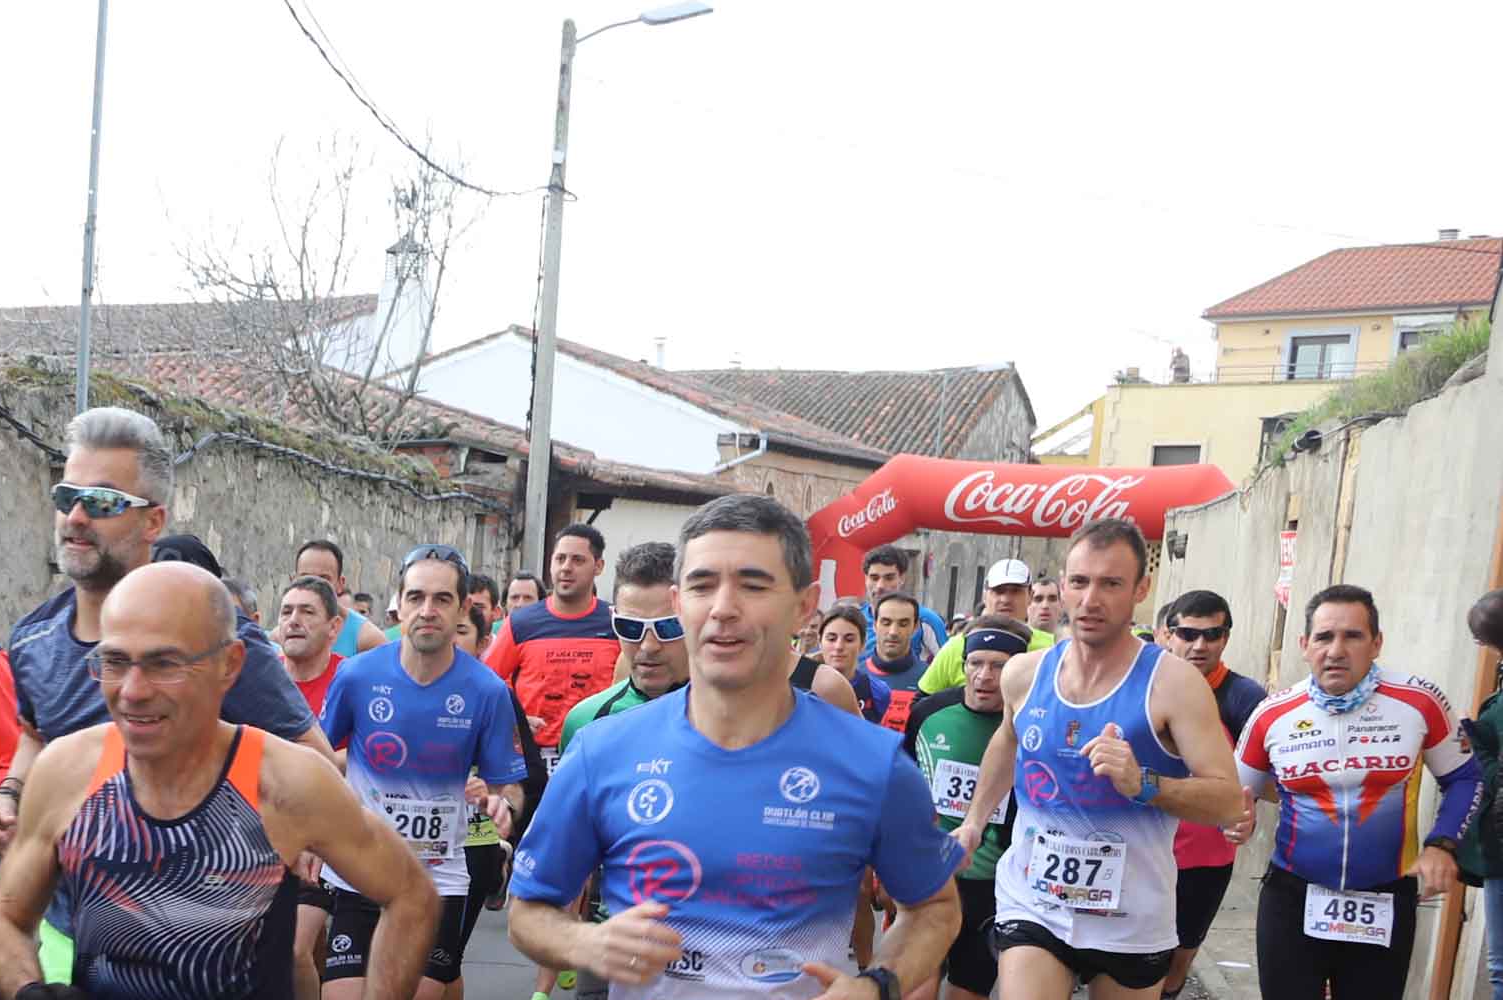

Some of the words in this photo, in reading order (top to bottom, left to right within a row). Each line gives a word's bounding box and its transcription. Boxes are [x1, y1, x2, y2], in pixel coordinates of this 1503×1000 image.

[1288, 729, 1323, 741] SPD
[1347, 733, 1402, 745] POLAR
[1280, 755, 1411, 778] MACARIO
[946, 776, 976, 802] 33
[394, 813, 443, 840] 208
[1043, 853, 1103, 888] 287
[1323, 898, 1376, 925] 485
